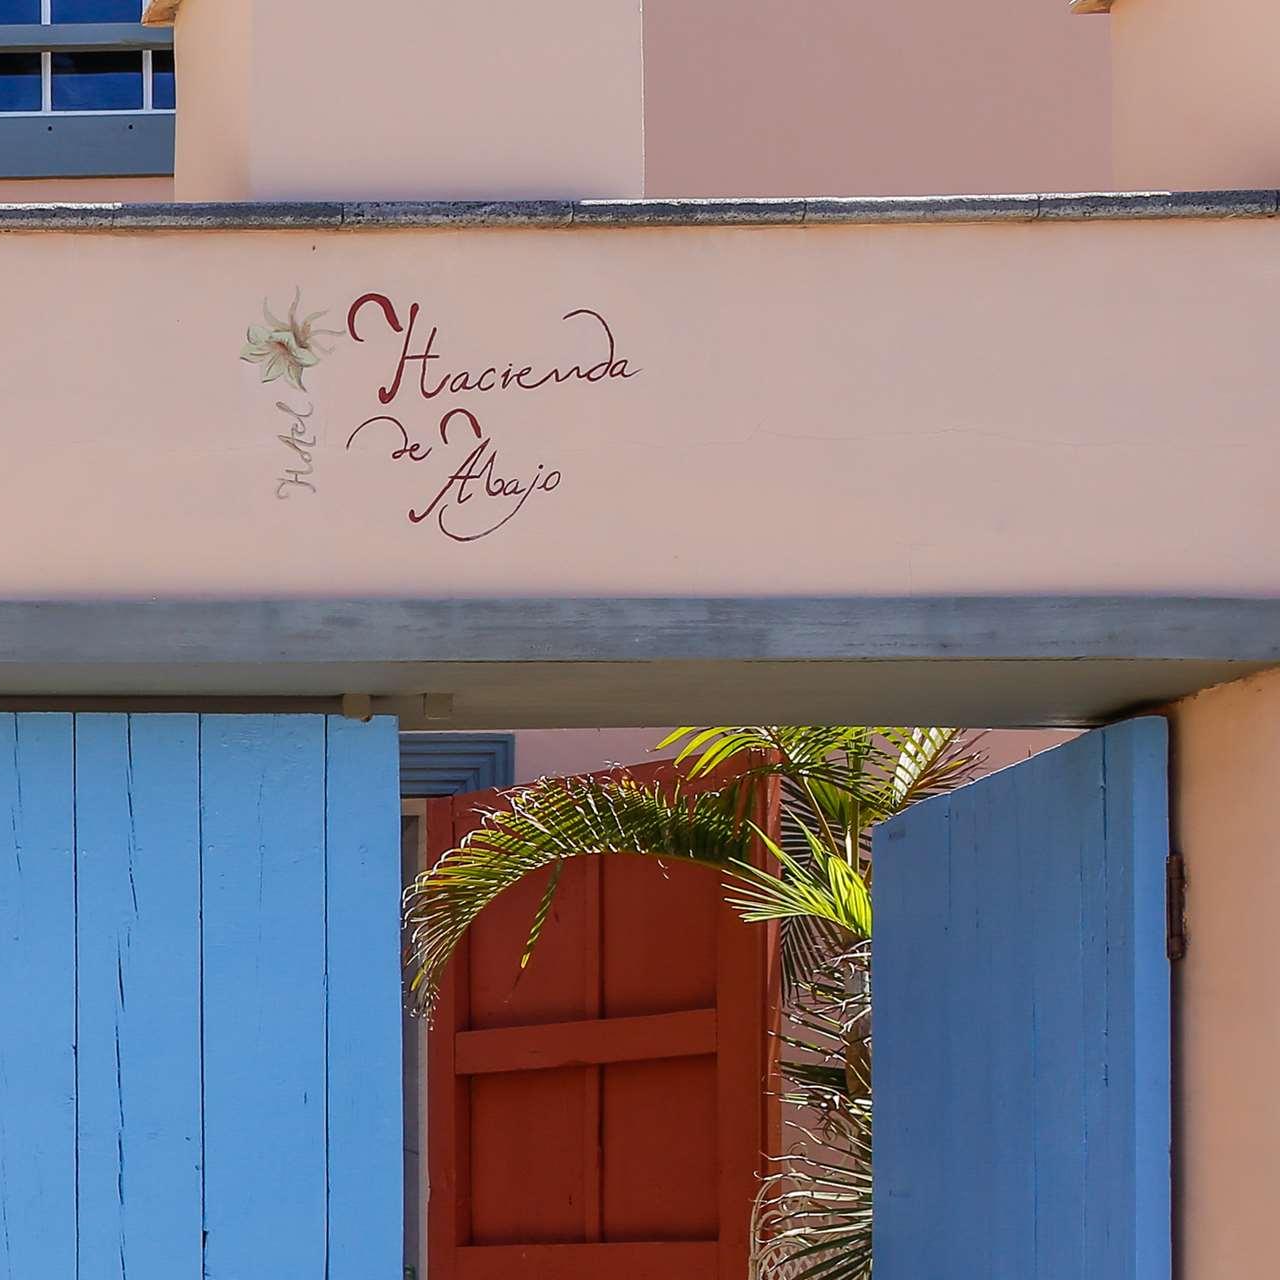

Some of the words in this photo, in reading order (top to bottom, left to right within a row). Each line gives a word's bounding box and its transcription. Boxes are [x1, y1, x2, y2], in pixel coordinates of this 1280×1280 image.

[347, 293, 642, 404] Hacienda
[274, 401, 317, 499] Hotel
[346, 416, 432, 461] de
[408, 408, 561, 542] Abajo
